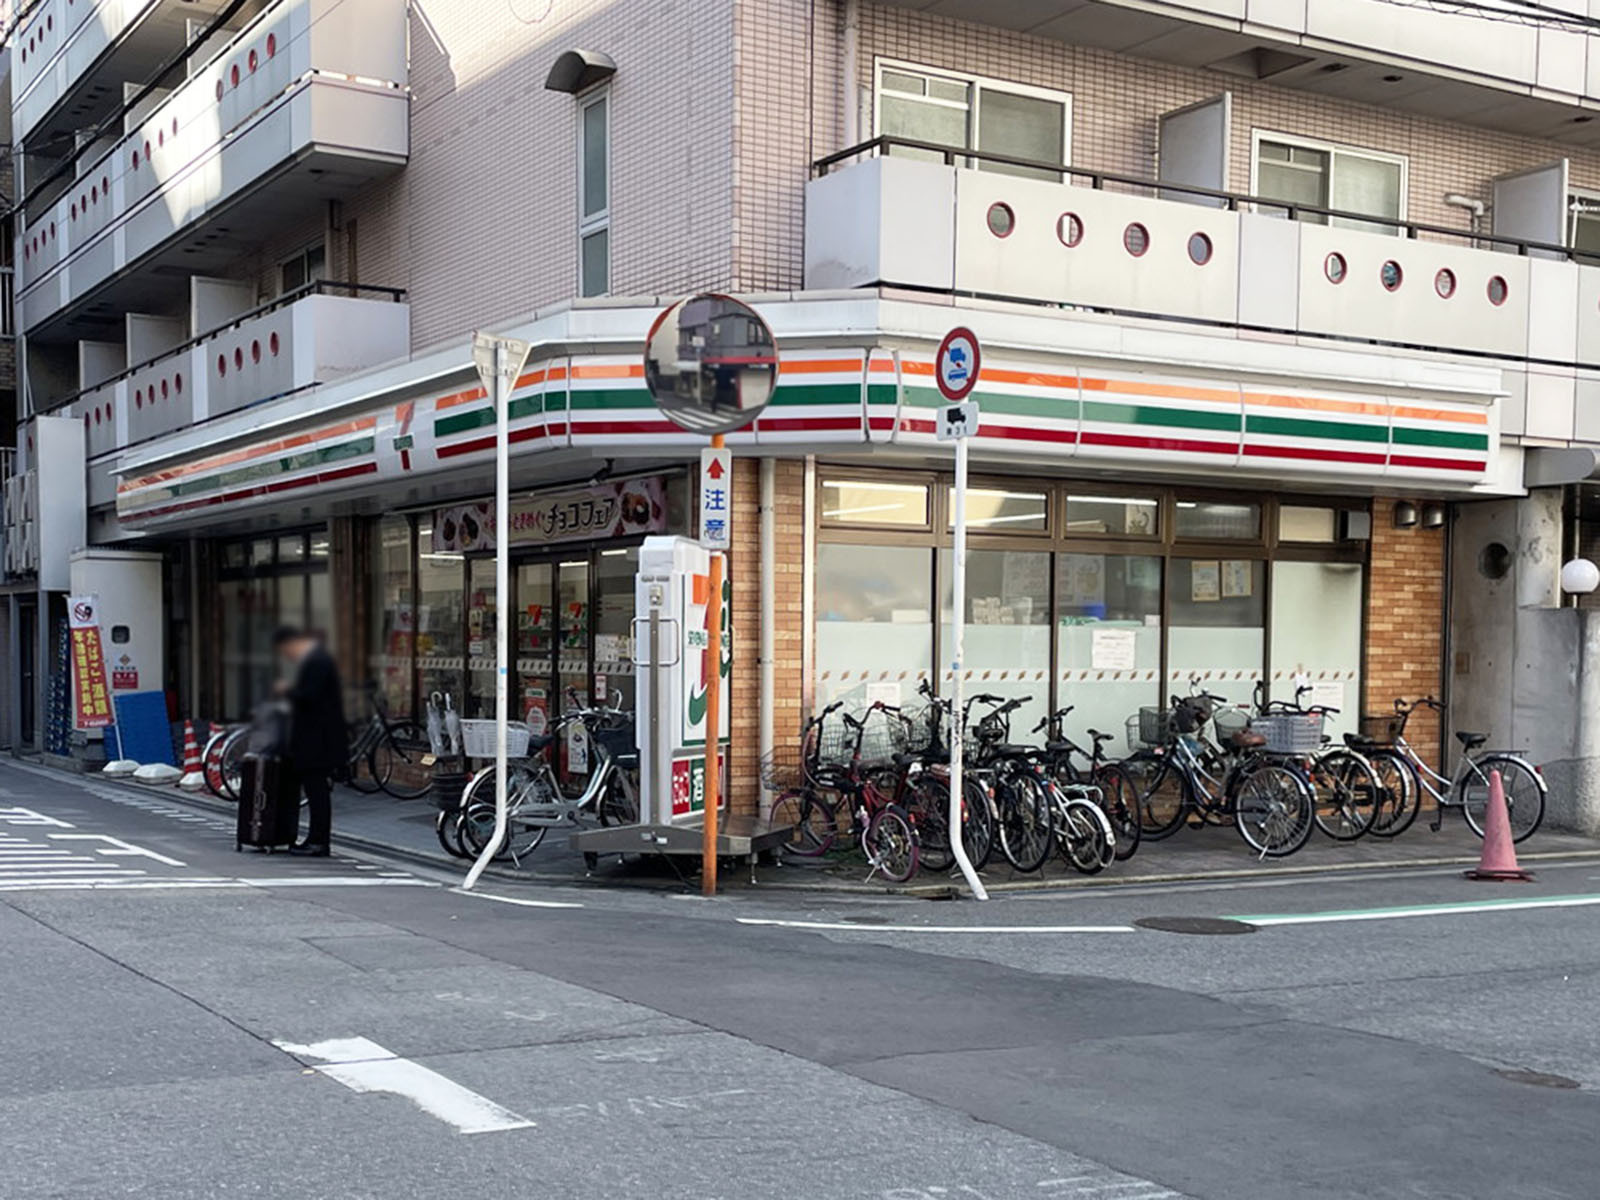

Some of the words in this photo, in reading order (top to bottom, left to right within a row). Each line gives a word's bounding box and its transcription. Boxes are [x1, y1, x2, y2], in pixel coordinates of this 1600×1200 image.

[544, 499, 616, 534] チョコフェア
